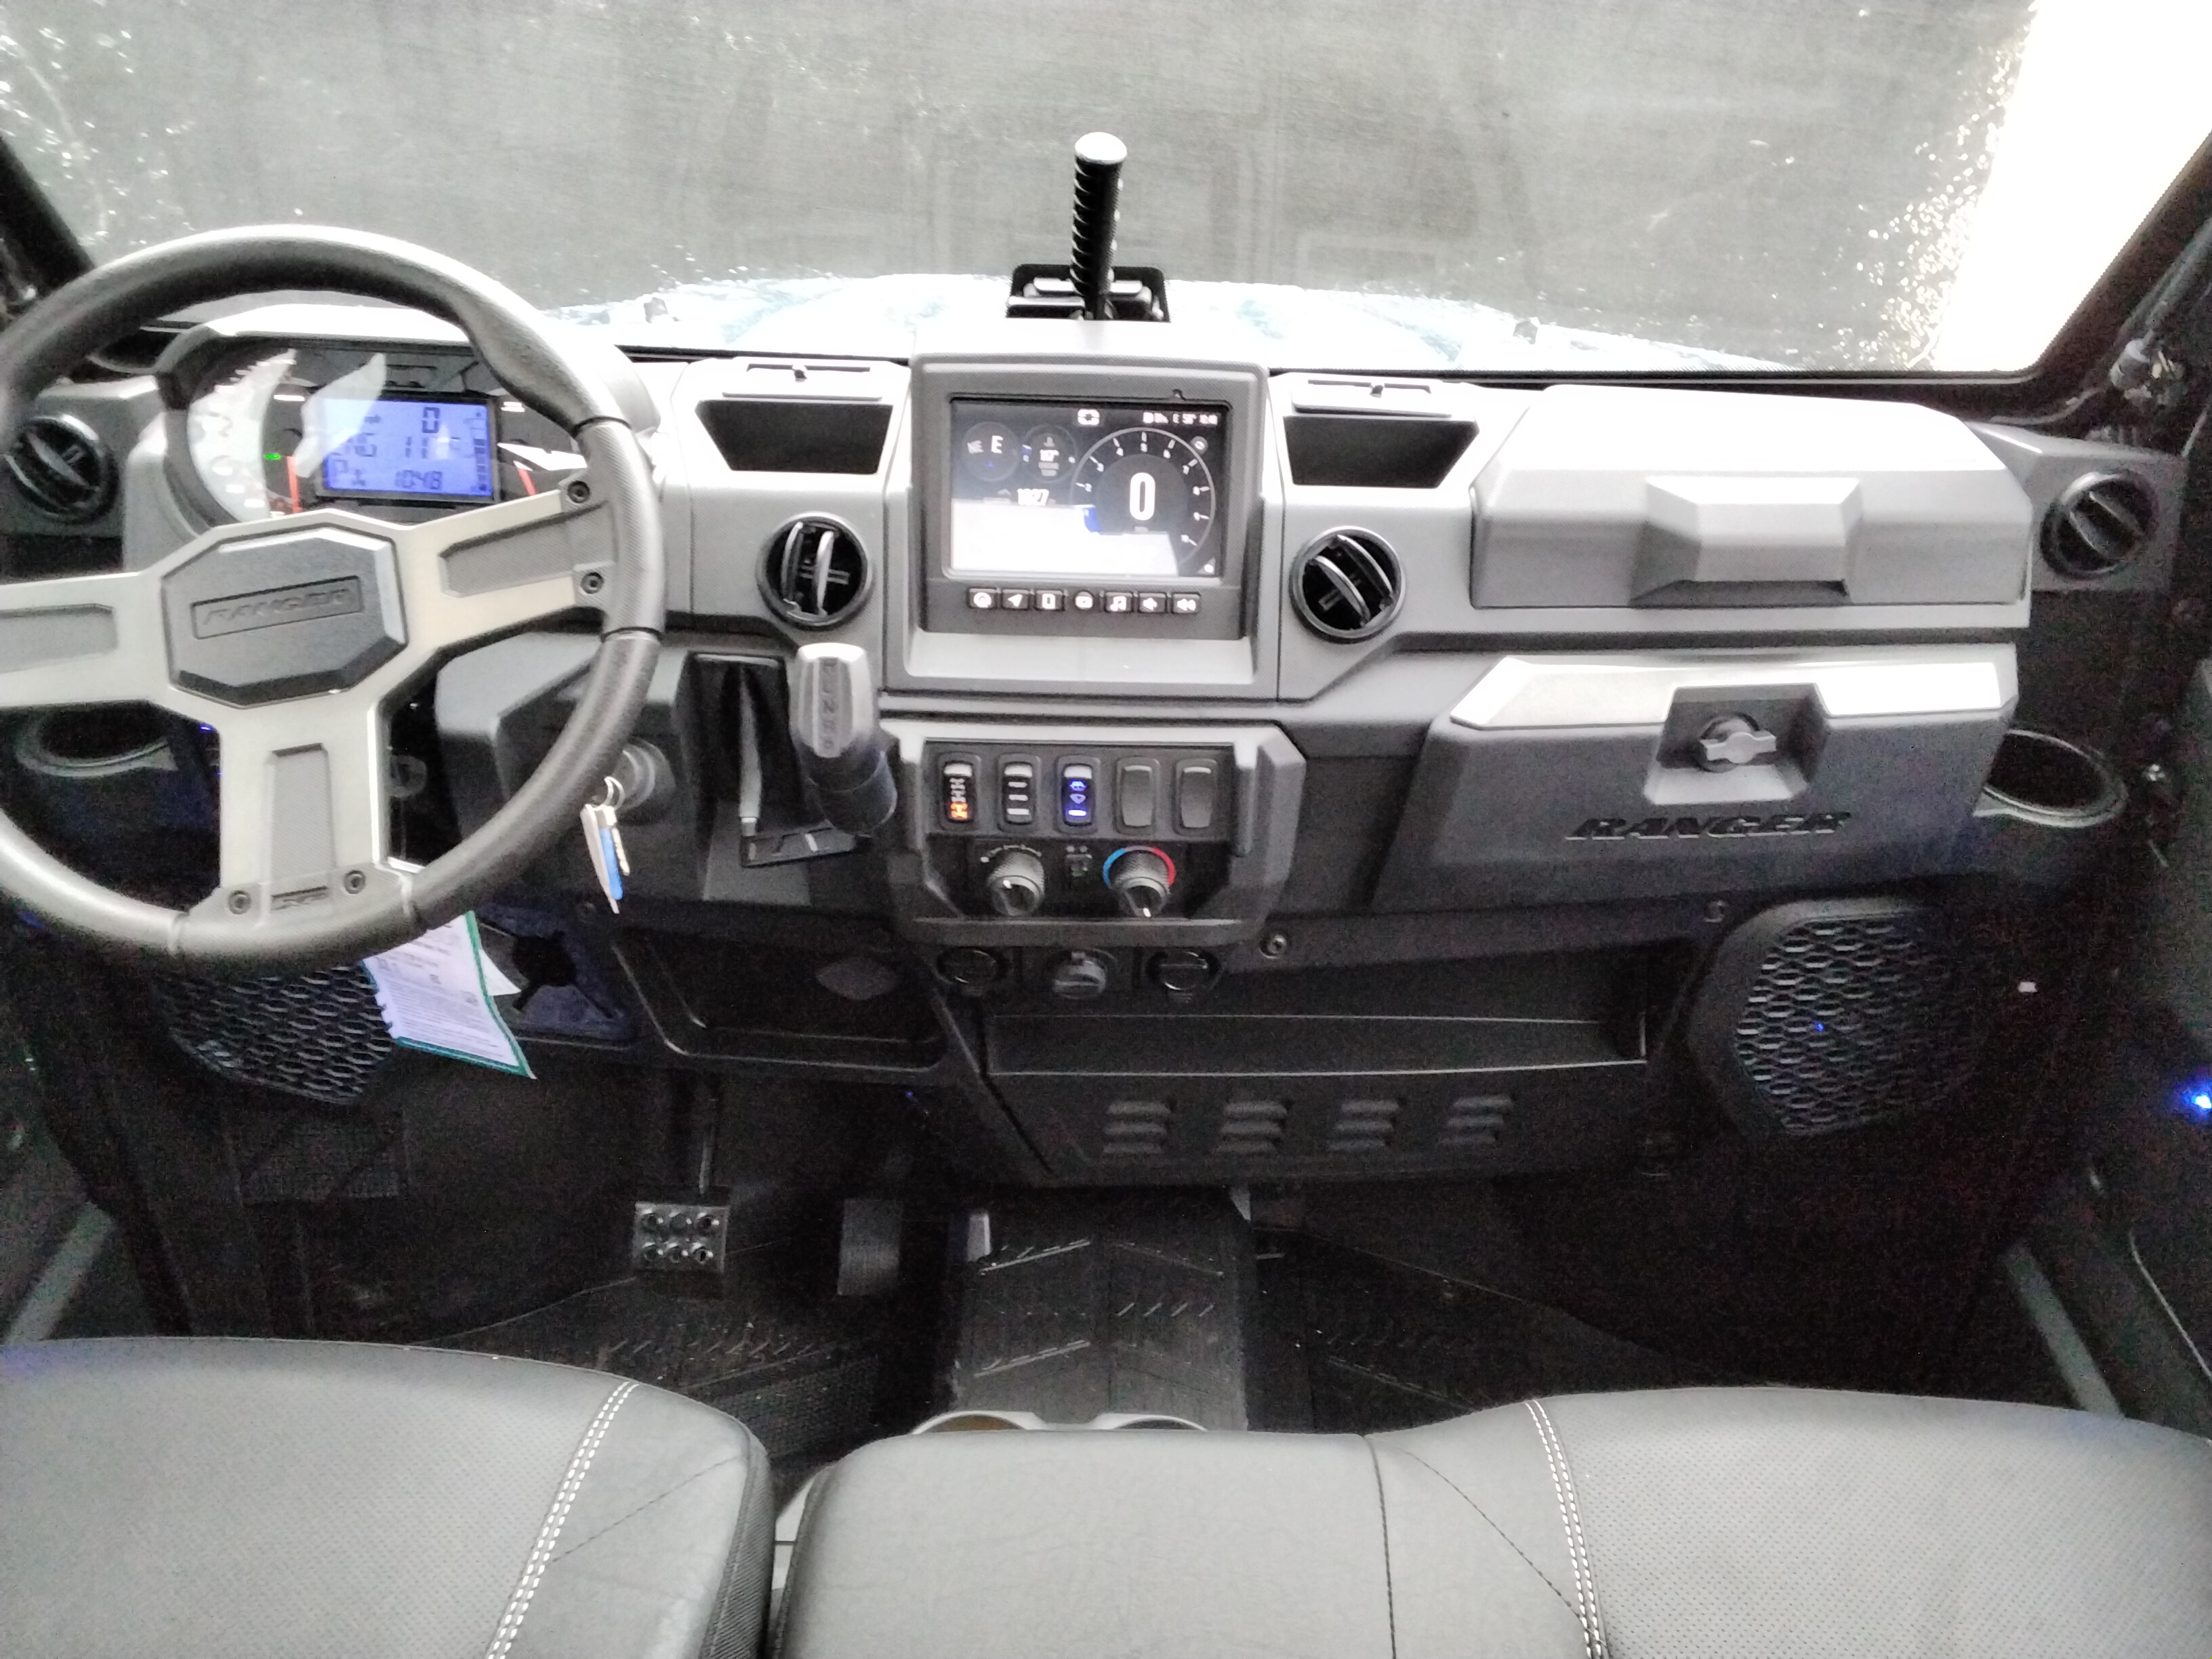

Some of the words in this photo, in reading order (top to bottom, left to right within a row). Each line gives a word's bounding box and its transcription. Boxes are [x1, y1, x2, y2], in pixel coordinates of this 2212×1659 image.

[422, 407, 441, 434] 0
[991, 434, 1004, 454] E
[1129, 472, 1156, 521] 0
[1565, 812, 1851, 841] RANGER
